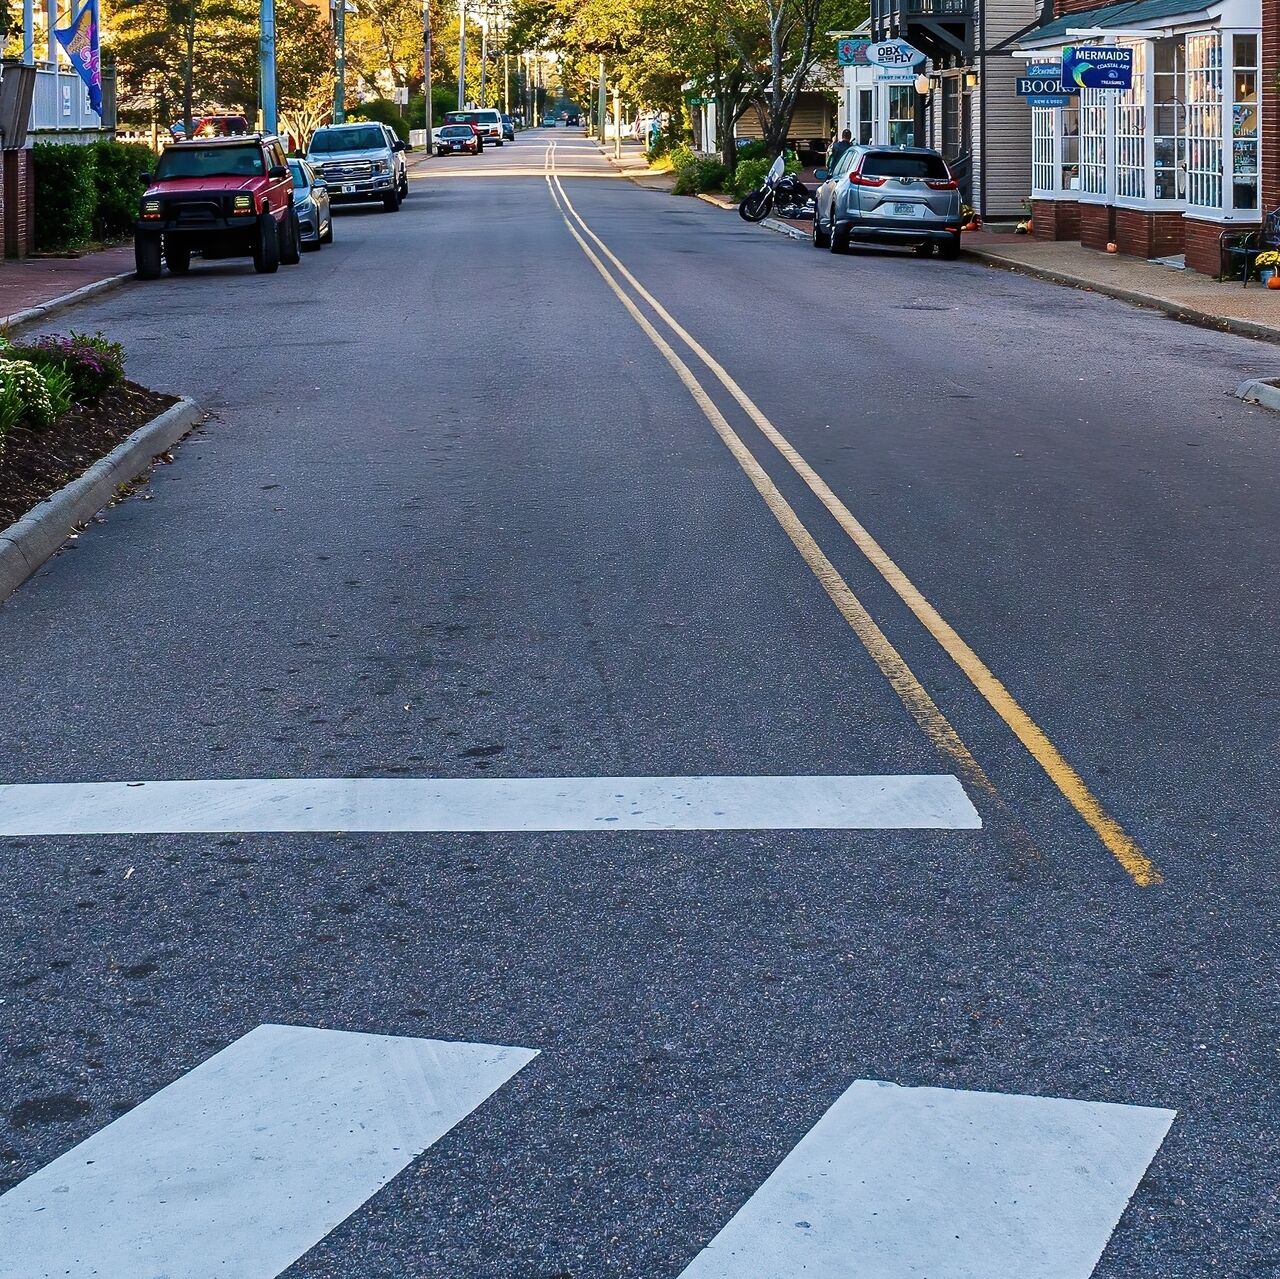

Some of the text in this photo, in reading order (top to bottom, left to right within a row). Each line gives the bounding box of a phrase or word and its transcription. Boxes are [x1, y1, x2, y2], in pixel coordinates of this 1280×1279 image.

[878, 45, 900, 57] OBX
[1075, 50, 1130, 61] MERMAIDS
[894, 53, 913, 64] FLY
